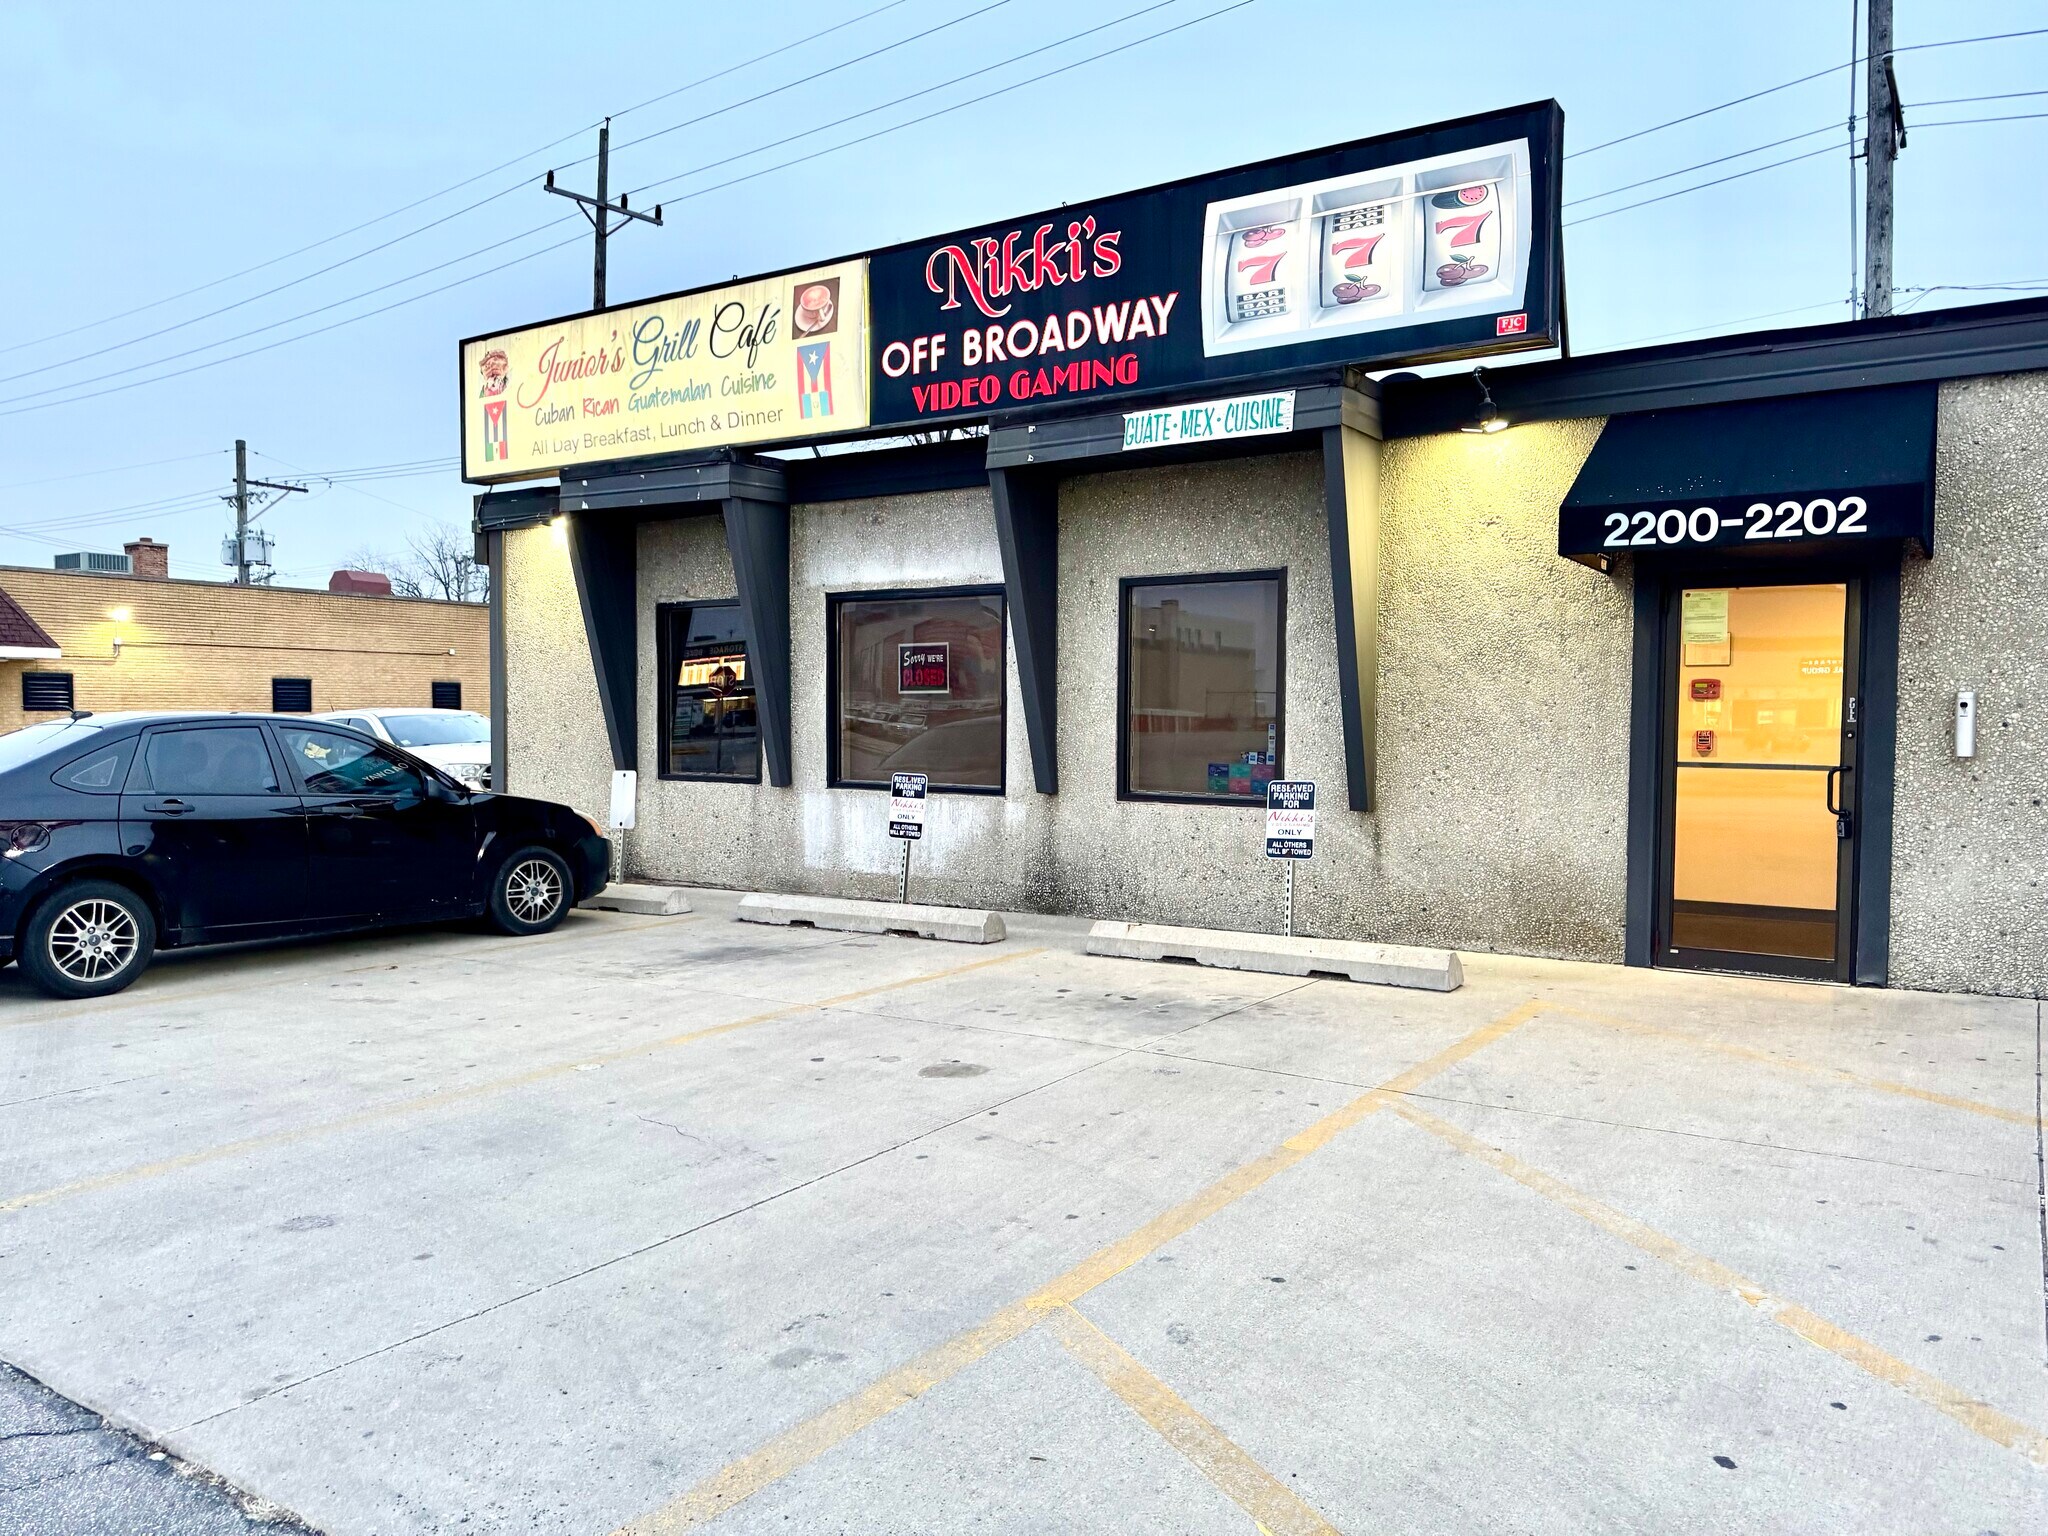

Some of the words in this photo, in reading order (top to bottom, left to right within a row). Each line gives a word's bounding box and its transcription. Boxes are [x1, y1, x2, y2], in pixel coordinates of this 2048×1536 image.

[1340, 212, 1377, 223] BAR
[1340, 219, 1377, 231] BAR
[1435, 210, 1493, 248] 7
[1331, 232, 1385, 269] 7
[926, 215, 1121, 317] Nikki's
[1237, 251, 1287, 285] 7
[1242, 290, 1280, 301] BAR
[1243, 299, 1280, 310] BAR
[1244, 308, 1281, 317] BAR
[1502, 317, 1521, 328] FJC
[881, 334, 946, 377] OFF
[962, 292, 1179, 366] BROADWAY
[517, 330, 626, 409] Junior's
[629, 316, 701, 390] Grill
[709, 302, 780, 369] Café
[911, 374, 1001, 413] VIDEO
[1008, 353, 1139, 399] GAMING
[535, 402, 575, 426] Cuban
[582, 398, 620, 419] Rican
[628, 379, 711, 413] Guatemalan
[721, 371, 777, 397] Cuisine
[1224, 398, 1285, 433] CUISINE
[532, 440, 548, 456] All
[583, 425, 657, 449] Breakfast,
[660, 417, 705, 438] Lunch
[710, 414, 722, 431] &
[727, 408, 784, 429] Dinner
[1603, 496, 1868, 547] 2200-2202
[903, 651, 925, 666] Sorry
[927, 654, 944, 663] WE'RE
[903, 668, 945, 687] CLOSED
[895, 783, 923, 791] PARKING
[1273, 792, 1310, 800] PARKING
[1283, 800, 1300, 808] FOR
[1268, 811, 1314, 823] Nikki's
[1283, 840, 1307, 849] OTHERS
